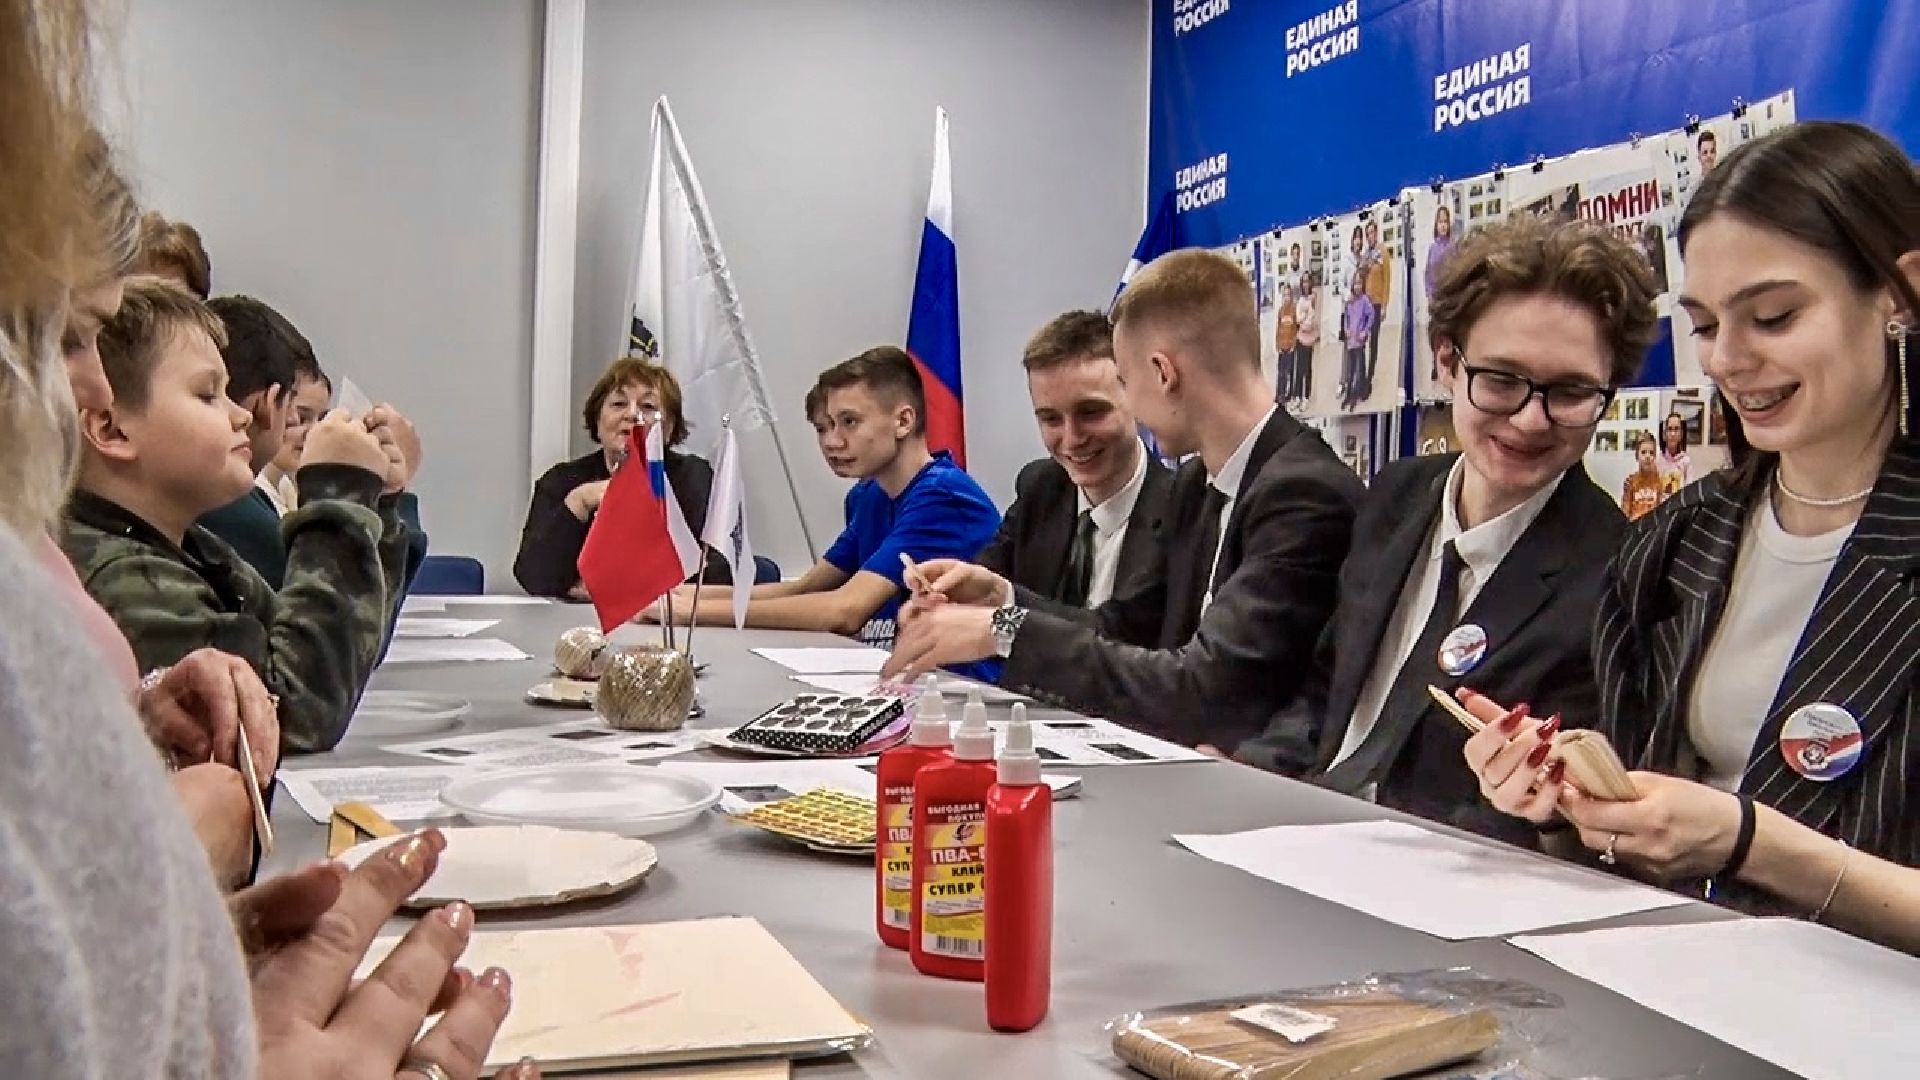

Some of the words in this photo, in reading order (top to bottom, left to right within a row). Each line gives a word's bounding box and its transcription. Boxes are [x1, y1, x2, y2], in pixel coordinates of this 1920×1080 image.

[1174, 0, 1229, 37] РОССИЯ
[1285, 0, 1358, 51] ЕДИНАЯ
[1286, 25, 1359, 78] РОССИЯ
[1435, 42, 1530, 100] ЕДИНАЯ
[1435, 75, 1530, 132] РОССИЯ
[1175, 152, 1227, 190] ЕДИНАЯ
[1176, 177, 1227, 214] РОССИЯ
[1578, 178, 1659, 223] ПОМНИ
[929, 882, 975, 896] СУПЕР
